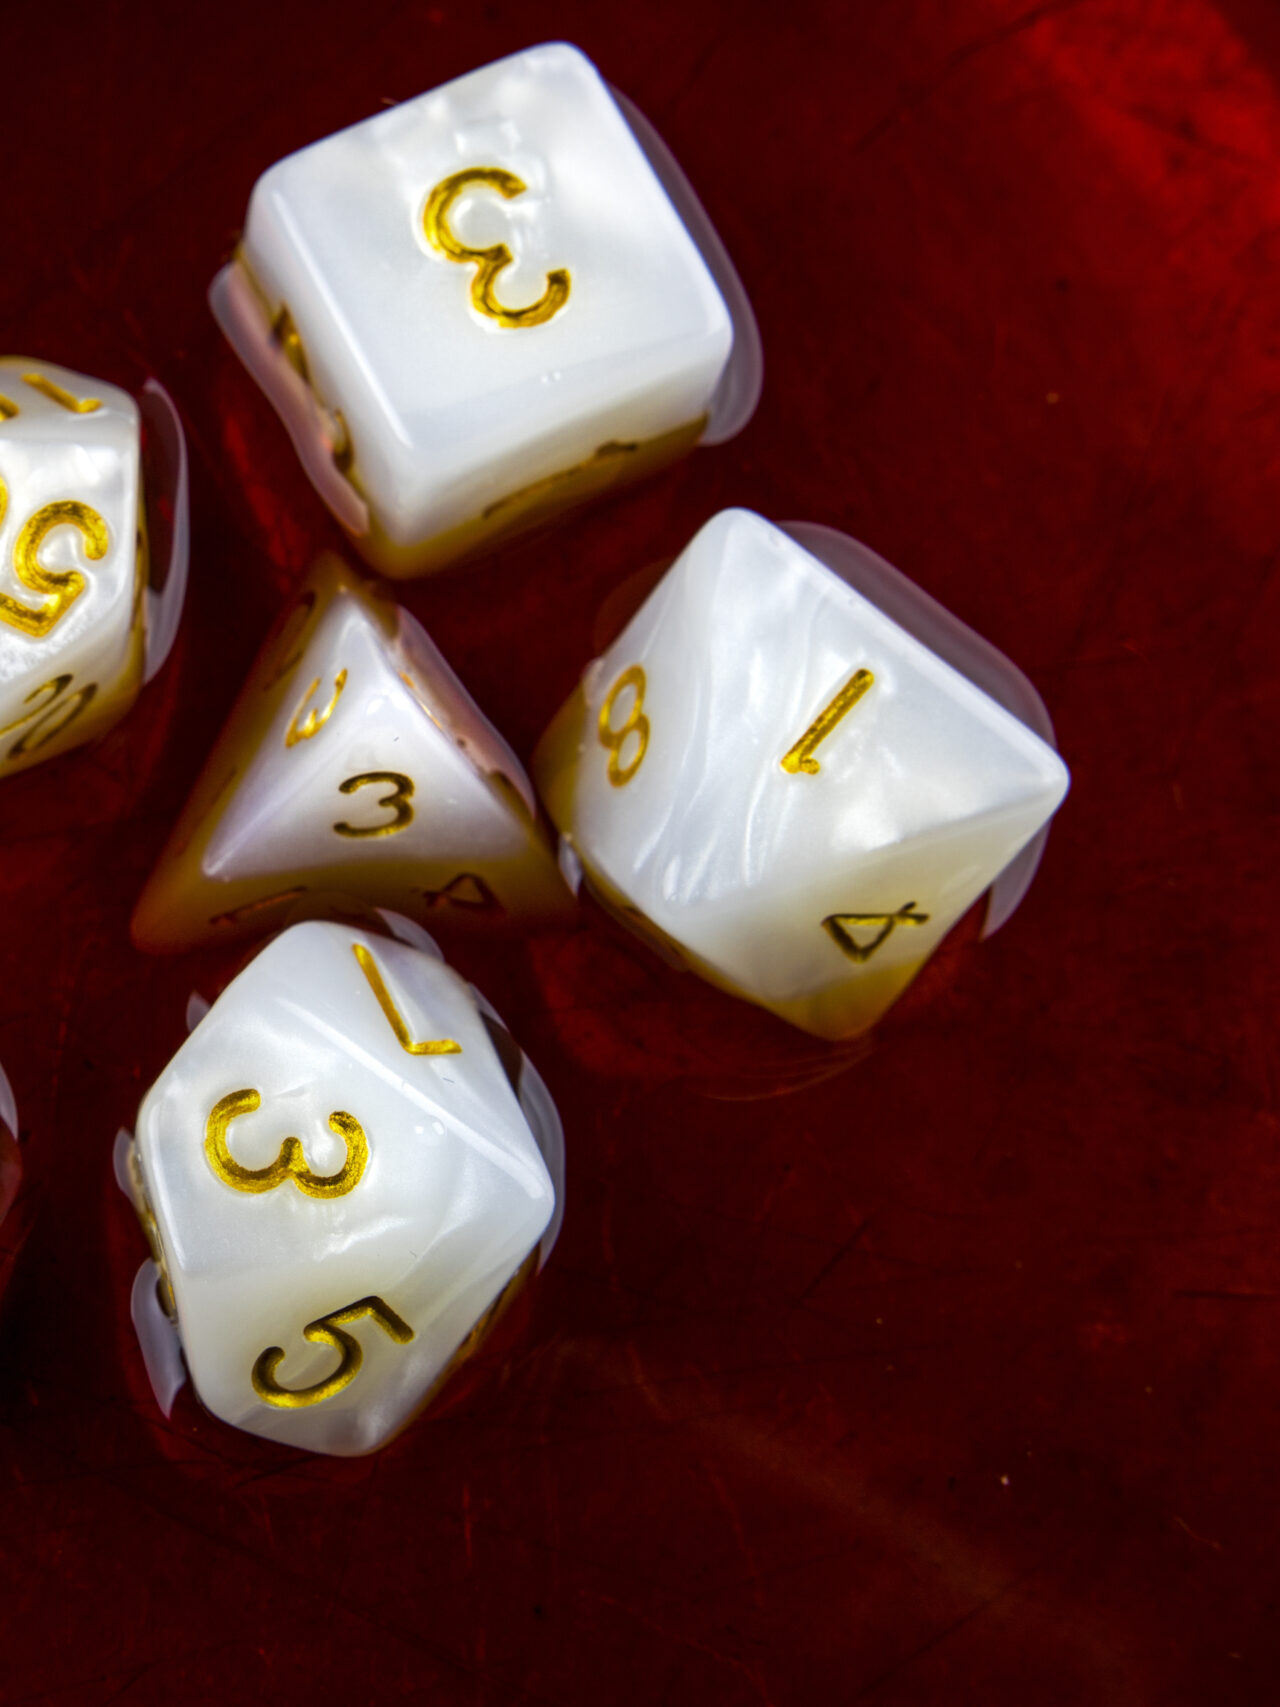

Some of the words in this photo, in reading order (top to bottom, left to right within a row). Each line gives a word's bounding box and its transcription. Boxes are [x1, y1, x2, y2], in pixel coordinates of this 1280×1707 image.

[422, 166, 572, 329] 3
[596, 664, 651, 789] 8
[780, 668, 875, 776] 1
[332, 771, 416, 840] 3
[820, 900, 931, 963] 4
[204, 1088, 369, 1200] 3
[250, 1295, 415, 1409] 5
